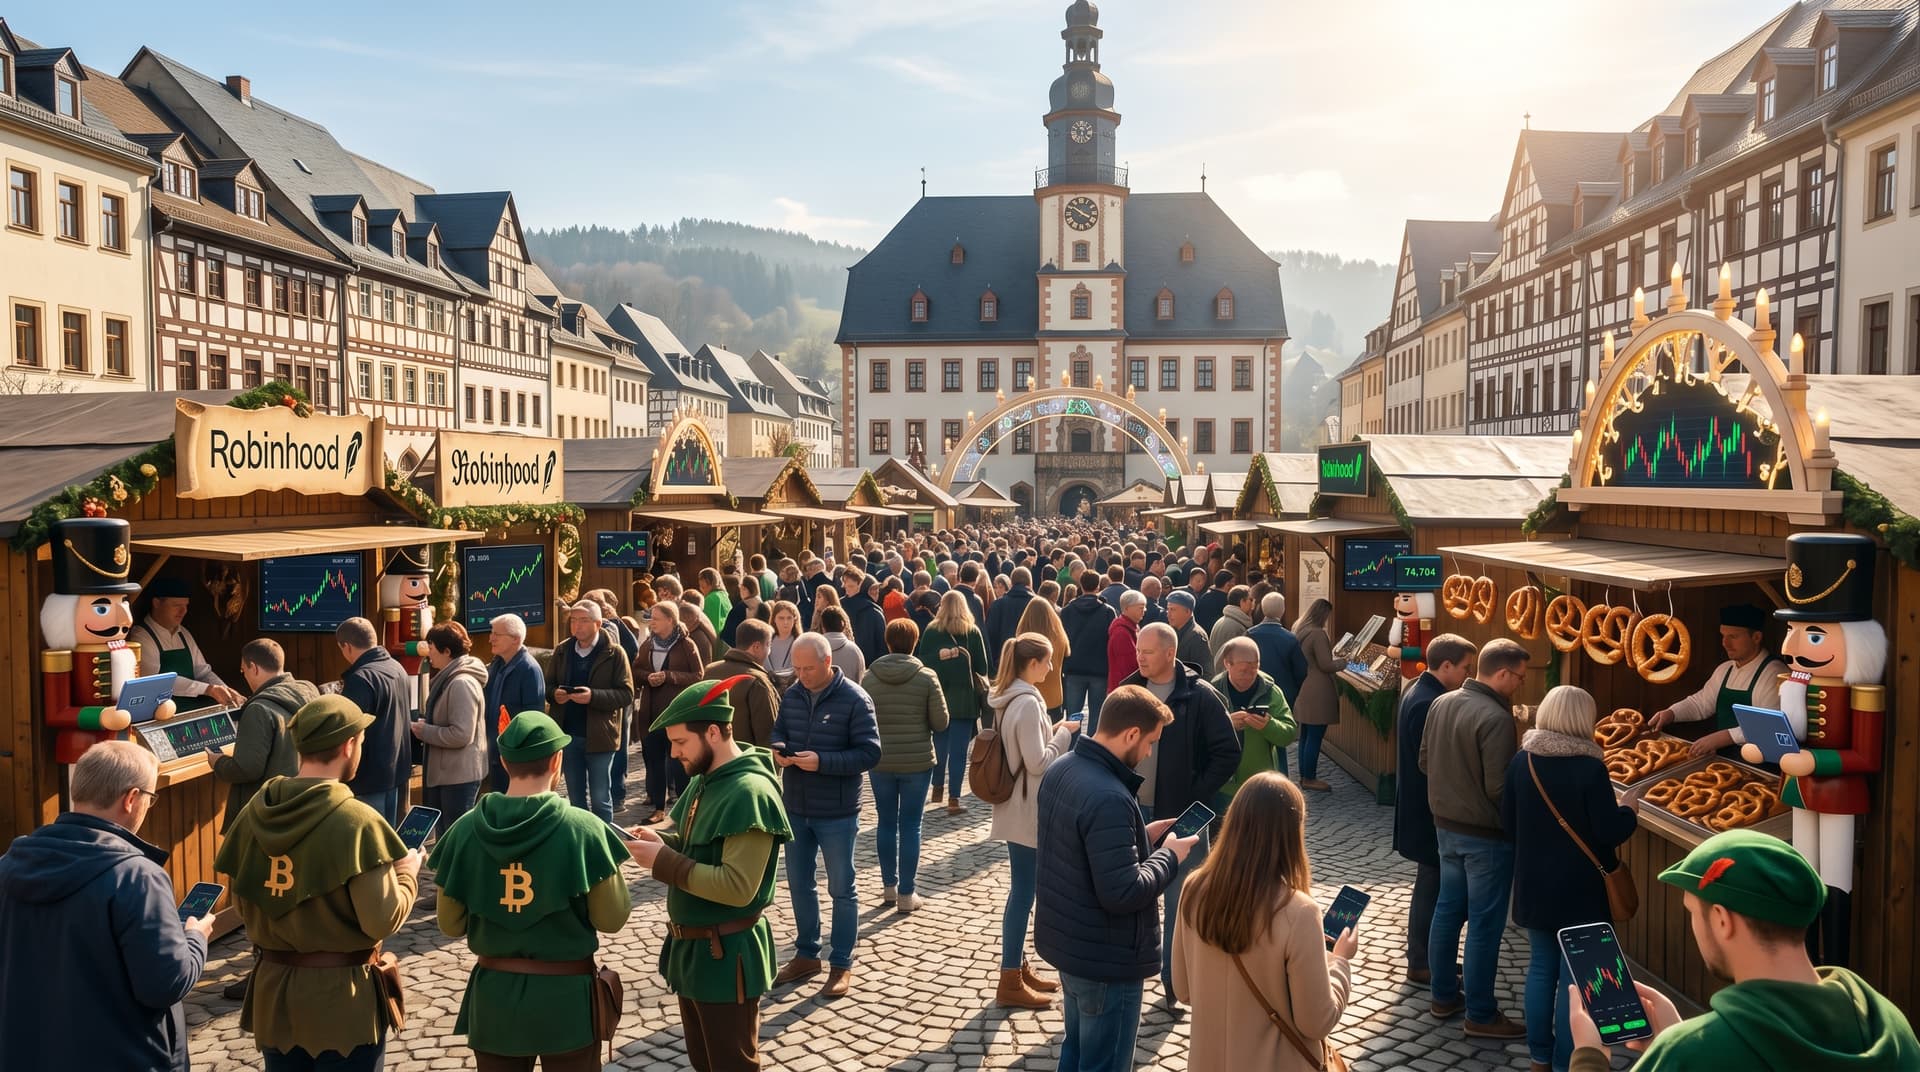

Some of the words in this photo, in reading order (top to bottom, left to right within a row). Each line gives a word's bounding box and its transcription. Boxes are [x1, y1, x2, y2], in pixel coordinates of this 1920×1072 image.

[211, 430, 339, 478] Robinhood
[452, 449, 539, 494] Robinhood
[1405, 567, 1436, 577] 74,704
